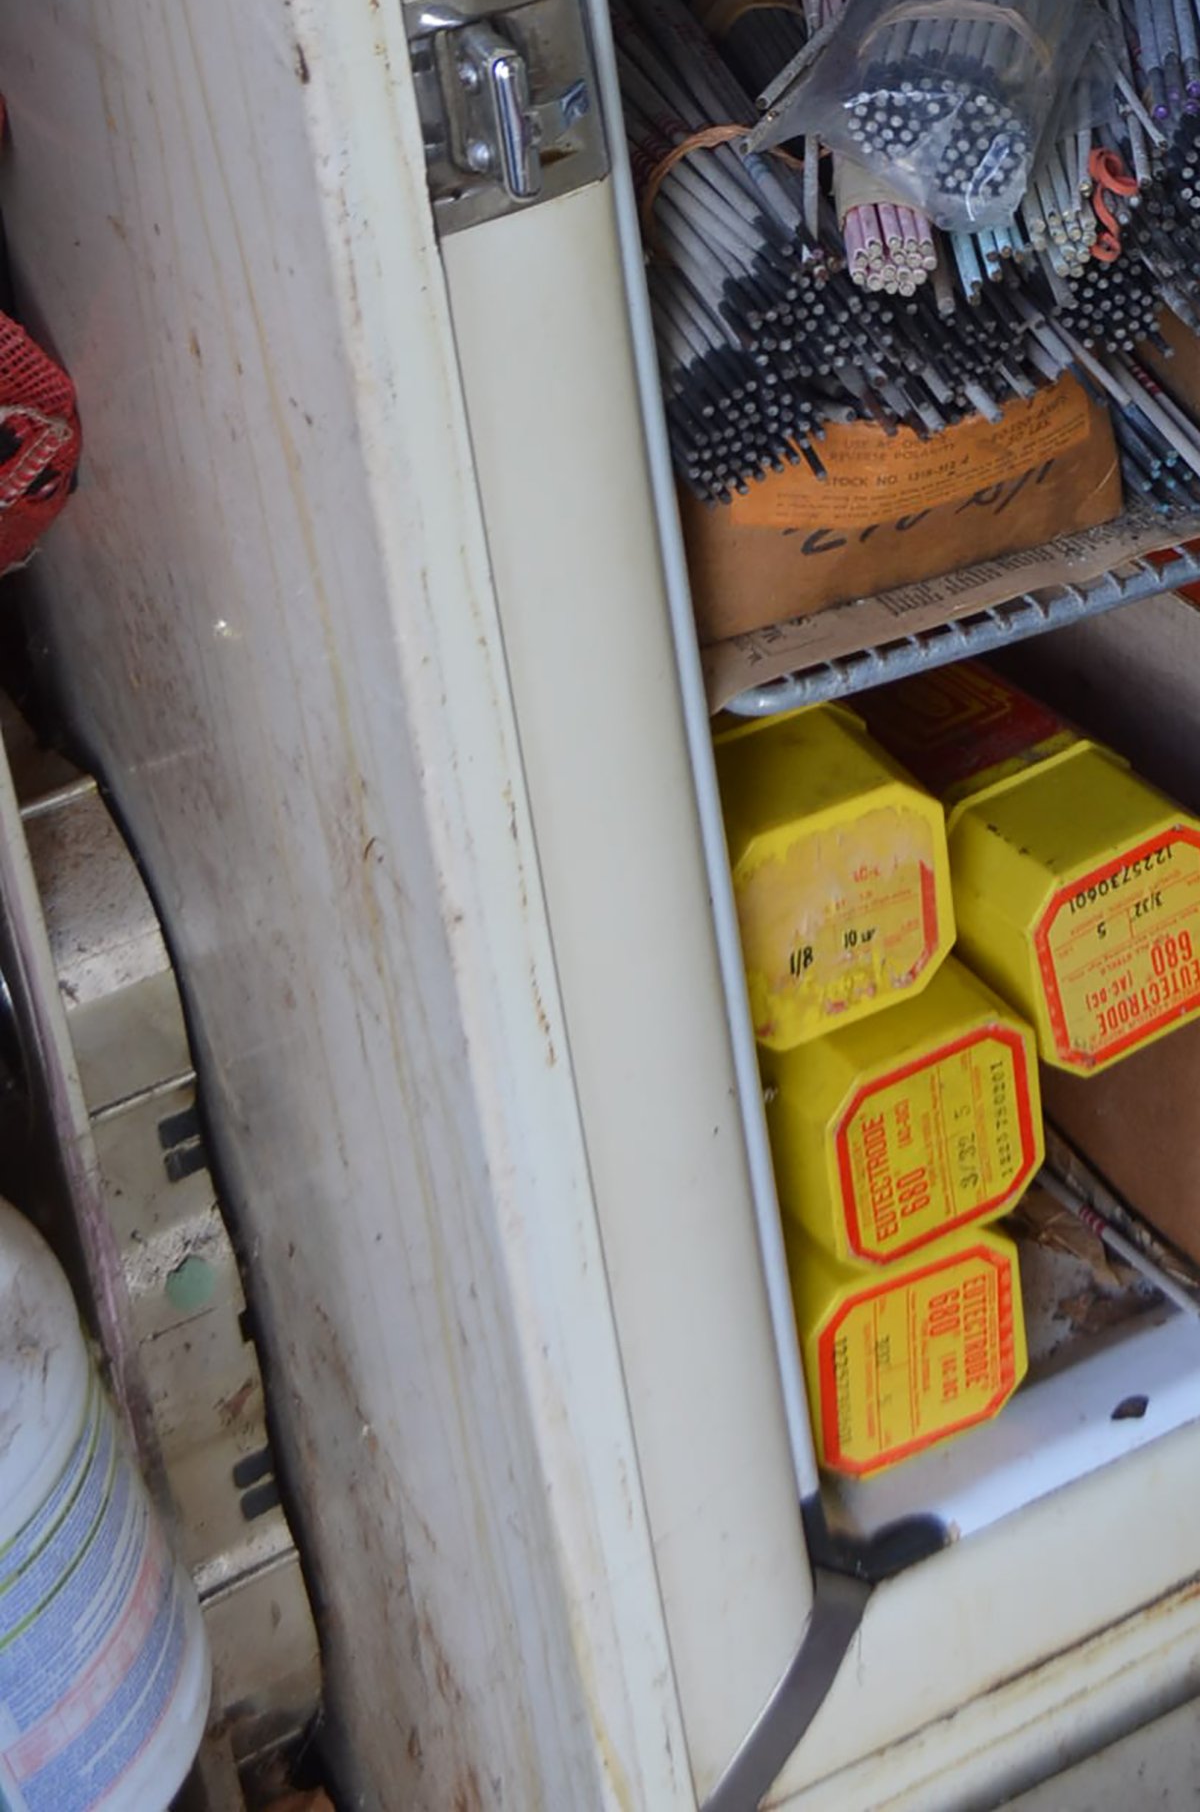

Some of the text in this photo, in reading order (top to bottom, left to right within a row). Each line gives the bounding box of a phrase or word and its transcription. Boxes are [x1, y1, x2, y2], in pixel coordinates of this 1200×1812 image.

[1151, 930, 1193, 976] 680
[861, 1112, 899, 1244] EUTECTRODE
[897, 1166, 931, 1219] 680
[928, 1288, 961, 1338] 680
[963, 1273, 989, 1389] EUTECTRODE
